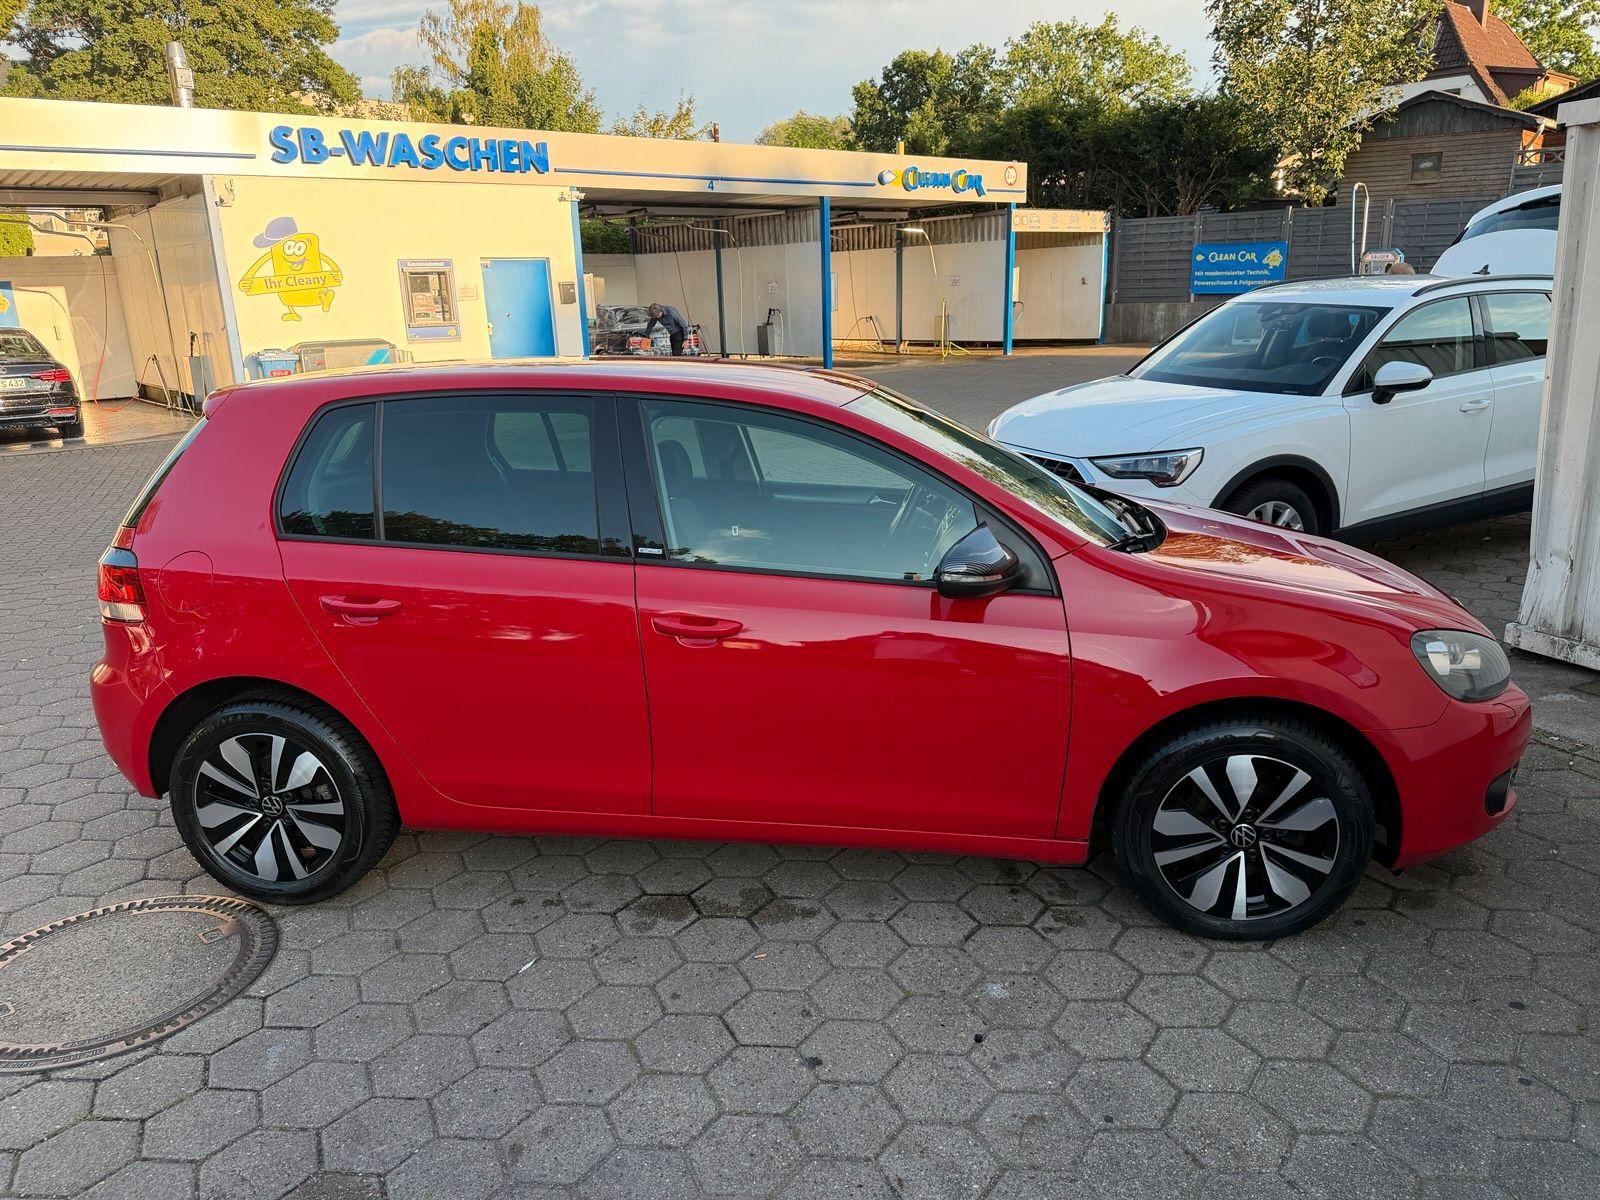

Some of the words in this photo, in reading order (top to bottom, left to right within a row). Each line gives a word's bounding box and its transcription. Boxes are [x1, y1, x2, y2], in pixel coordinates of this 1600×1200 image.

[269, 125, 550, 174] SB-WASCHEN
[707, 180, 715, 191] 4
[902, 166, 951, 191] CLEAN
[951, 168, 986, 197] CAR
[1208, 251, 1236, 263] CLEAN
[1238, 250, 1258, 263] CAR
[264, 279, 282, 289] Ihr
[285, 275, 327, 288] Cleany
[8, 379, 25, 387] 432
